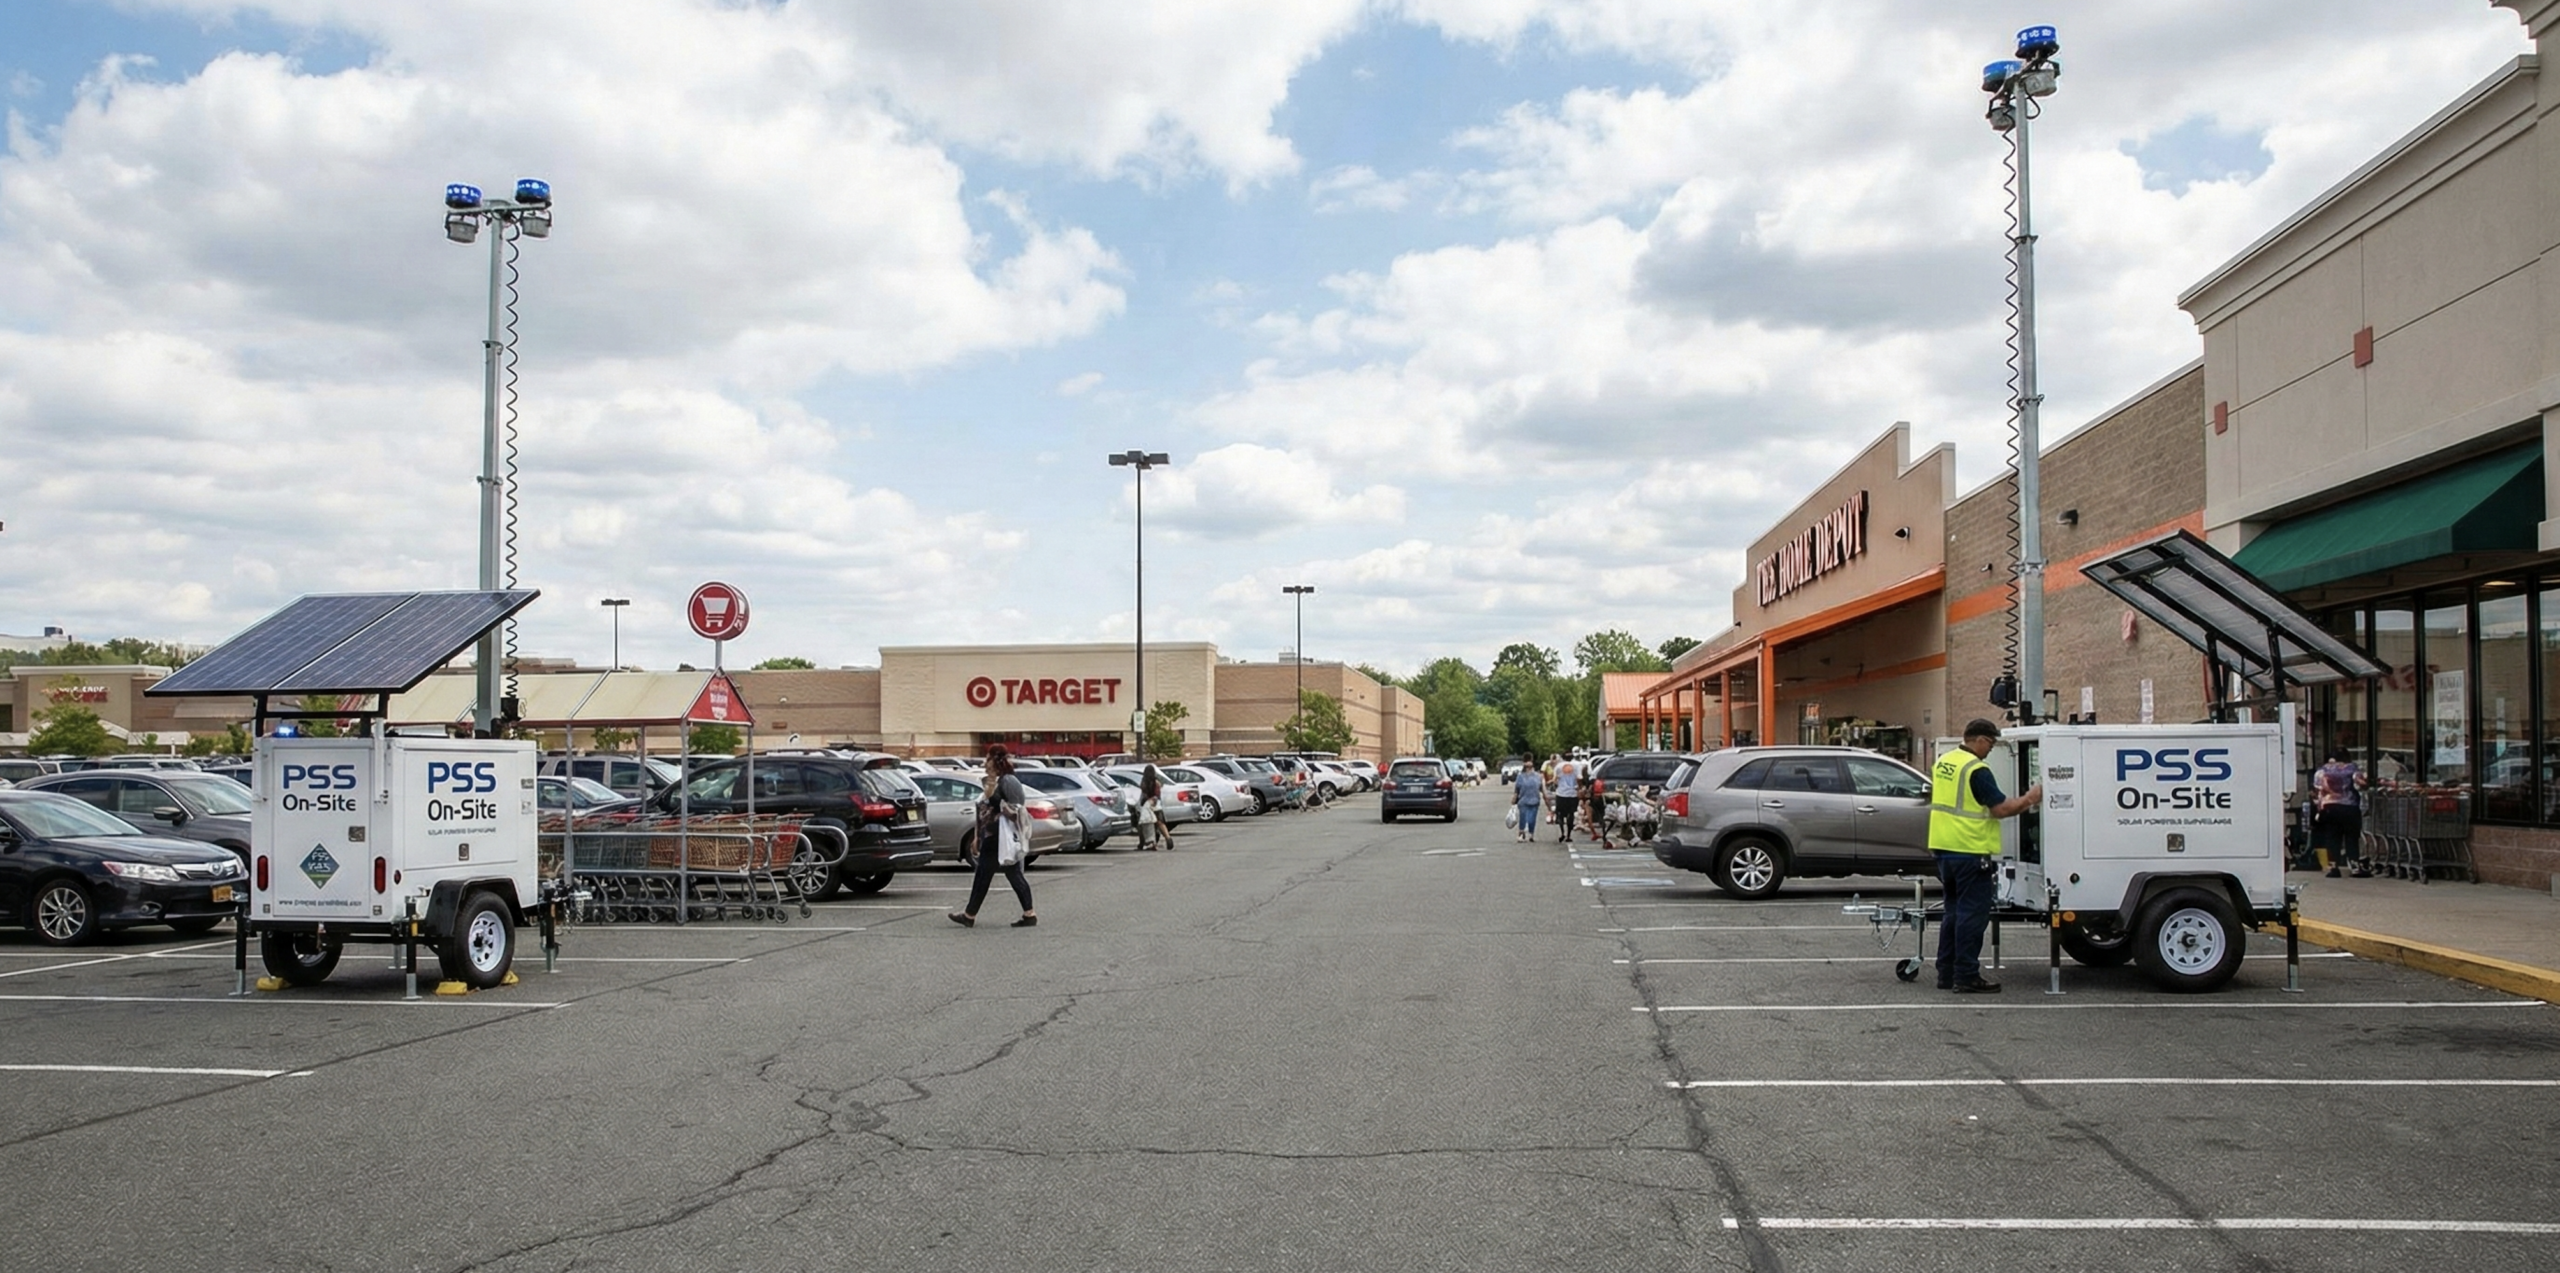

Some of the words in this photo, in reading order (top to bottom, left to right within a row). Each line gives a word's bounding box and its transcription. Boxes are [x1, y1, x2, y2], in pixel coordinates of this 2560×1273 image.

[1779, 528, 1812, 597] HOME
[1815, 490, 1864, 577] DEPOT
[1001, 678, 1122, 704] TARGET
[283, 764, 357, 790] PSS
[428, 762, 496, 794] PSS
[2116, 748, 2232, 782] PSS
[282, 793, 357, 812] On-Site
[427, 798, 497, 821] On-Site
[2117, 786, 2232, 810] On-Site
